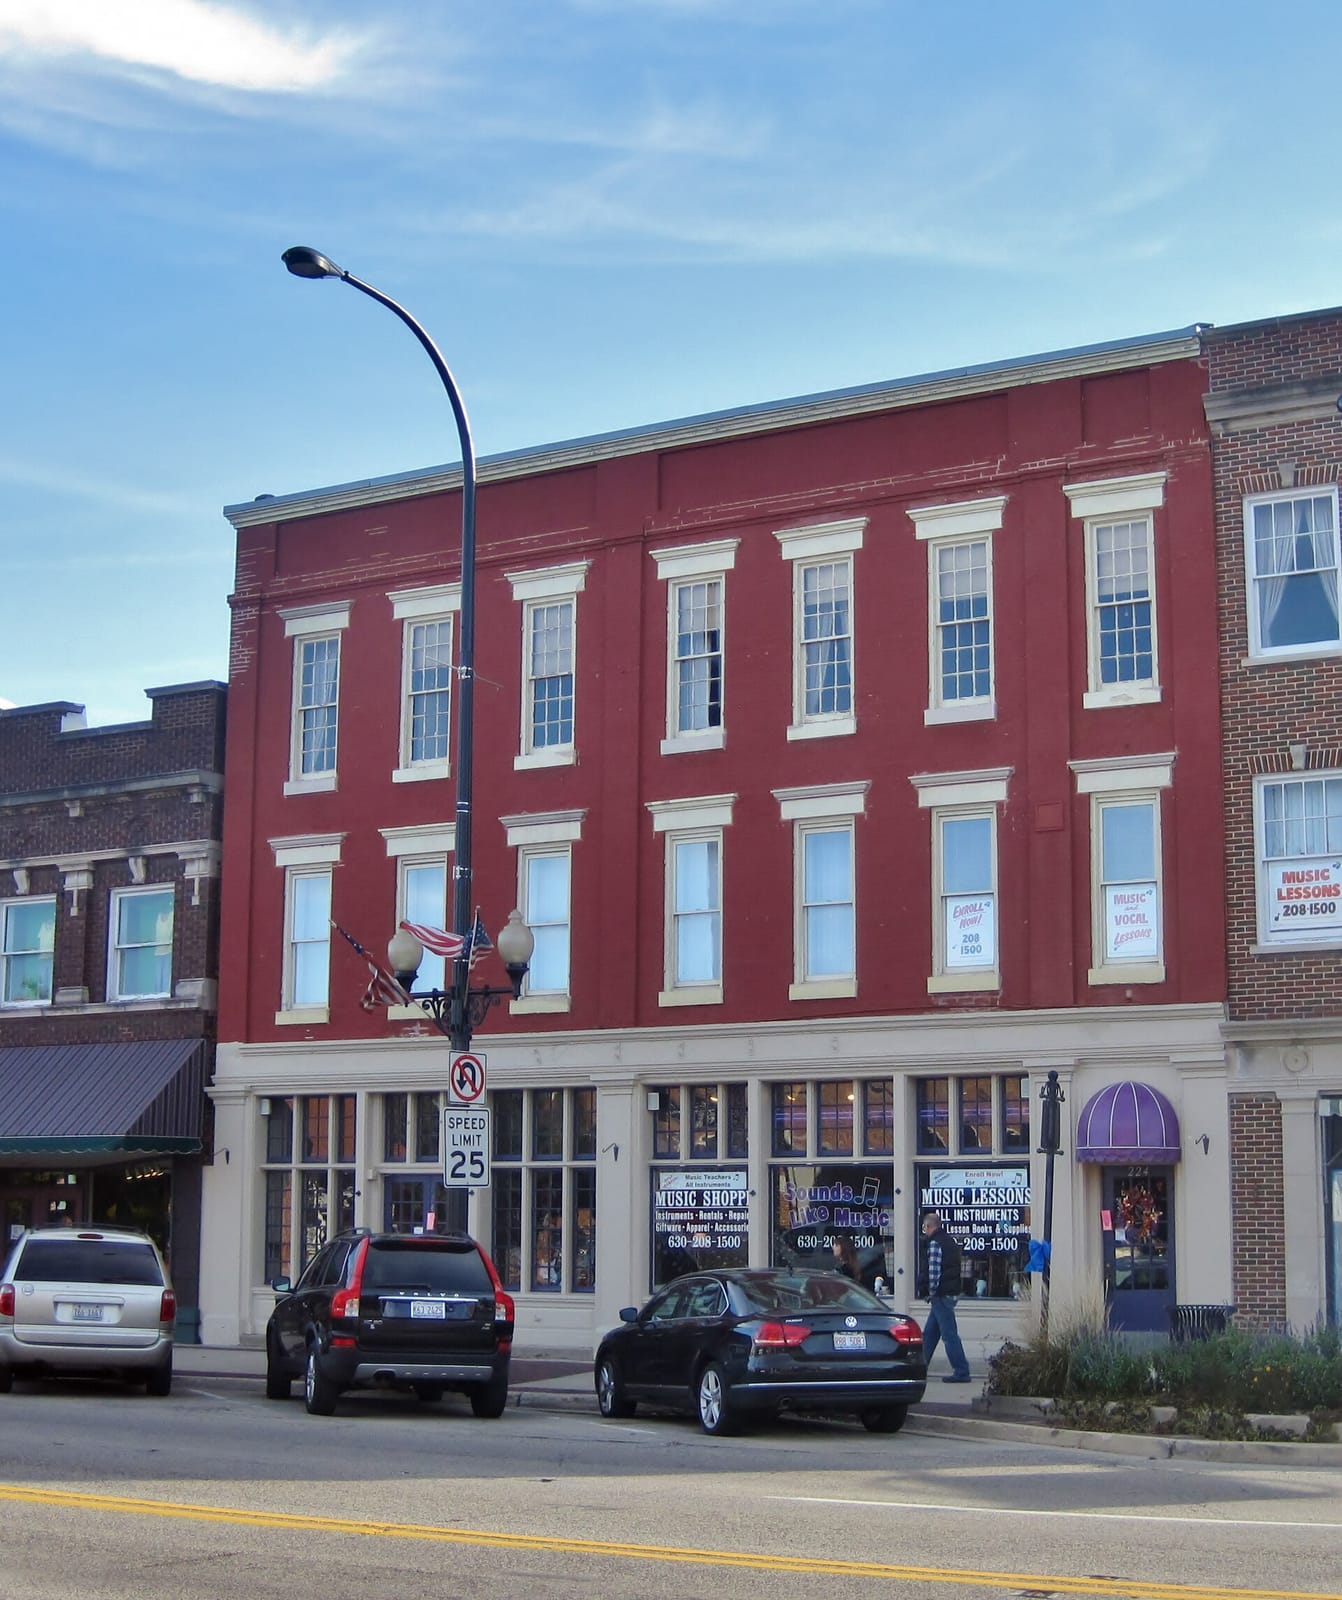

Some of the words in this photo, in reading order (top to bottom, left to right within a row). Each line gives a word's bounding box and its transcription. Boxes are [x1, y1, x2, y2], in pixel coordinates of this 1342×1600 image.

[1282, 868, 1330, 884] MUSIC
[1277, 883, 1341, 901] LESSONS
[1113, 893, 1146, 905] MUSIC
[1114, 913, 1149, 926] VOCAL
[962, 933, 980, 944] 208
[960, 944, 982, 955] 1500
[448, 1117, 486, 1130] SPEED
[452, 1134, 482, 1146] LIMIT
[450, 1150, 485, 1178] 25
[1127, 1166, 1149, 1177] 224
[656, 1190, 697, 1206] MUSIC
[784, 1181, 853, 1202] Sounds
[921, 1188, 965, 1205] MUSIC
[971, 1187, 1031, 1205] LESSONS
[655, 1210, 694, 1220] Instruments
[699, 1210, 724, 1220] Rentals
[789, 1206, 830, 1230] Like
[834, 1207, 890, 1228] Music
[953, 1208, 1020, 1222] INSTRUMENTS
[686, 1222, 710, 1233] Apparel
[946, 1223, 970, 1234] Lesson
[972, 1223, 993, 1234] Books
[668, 1235, 741, 1248] 630-208-1500
